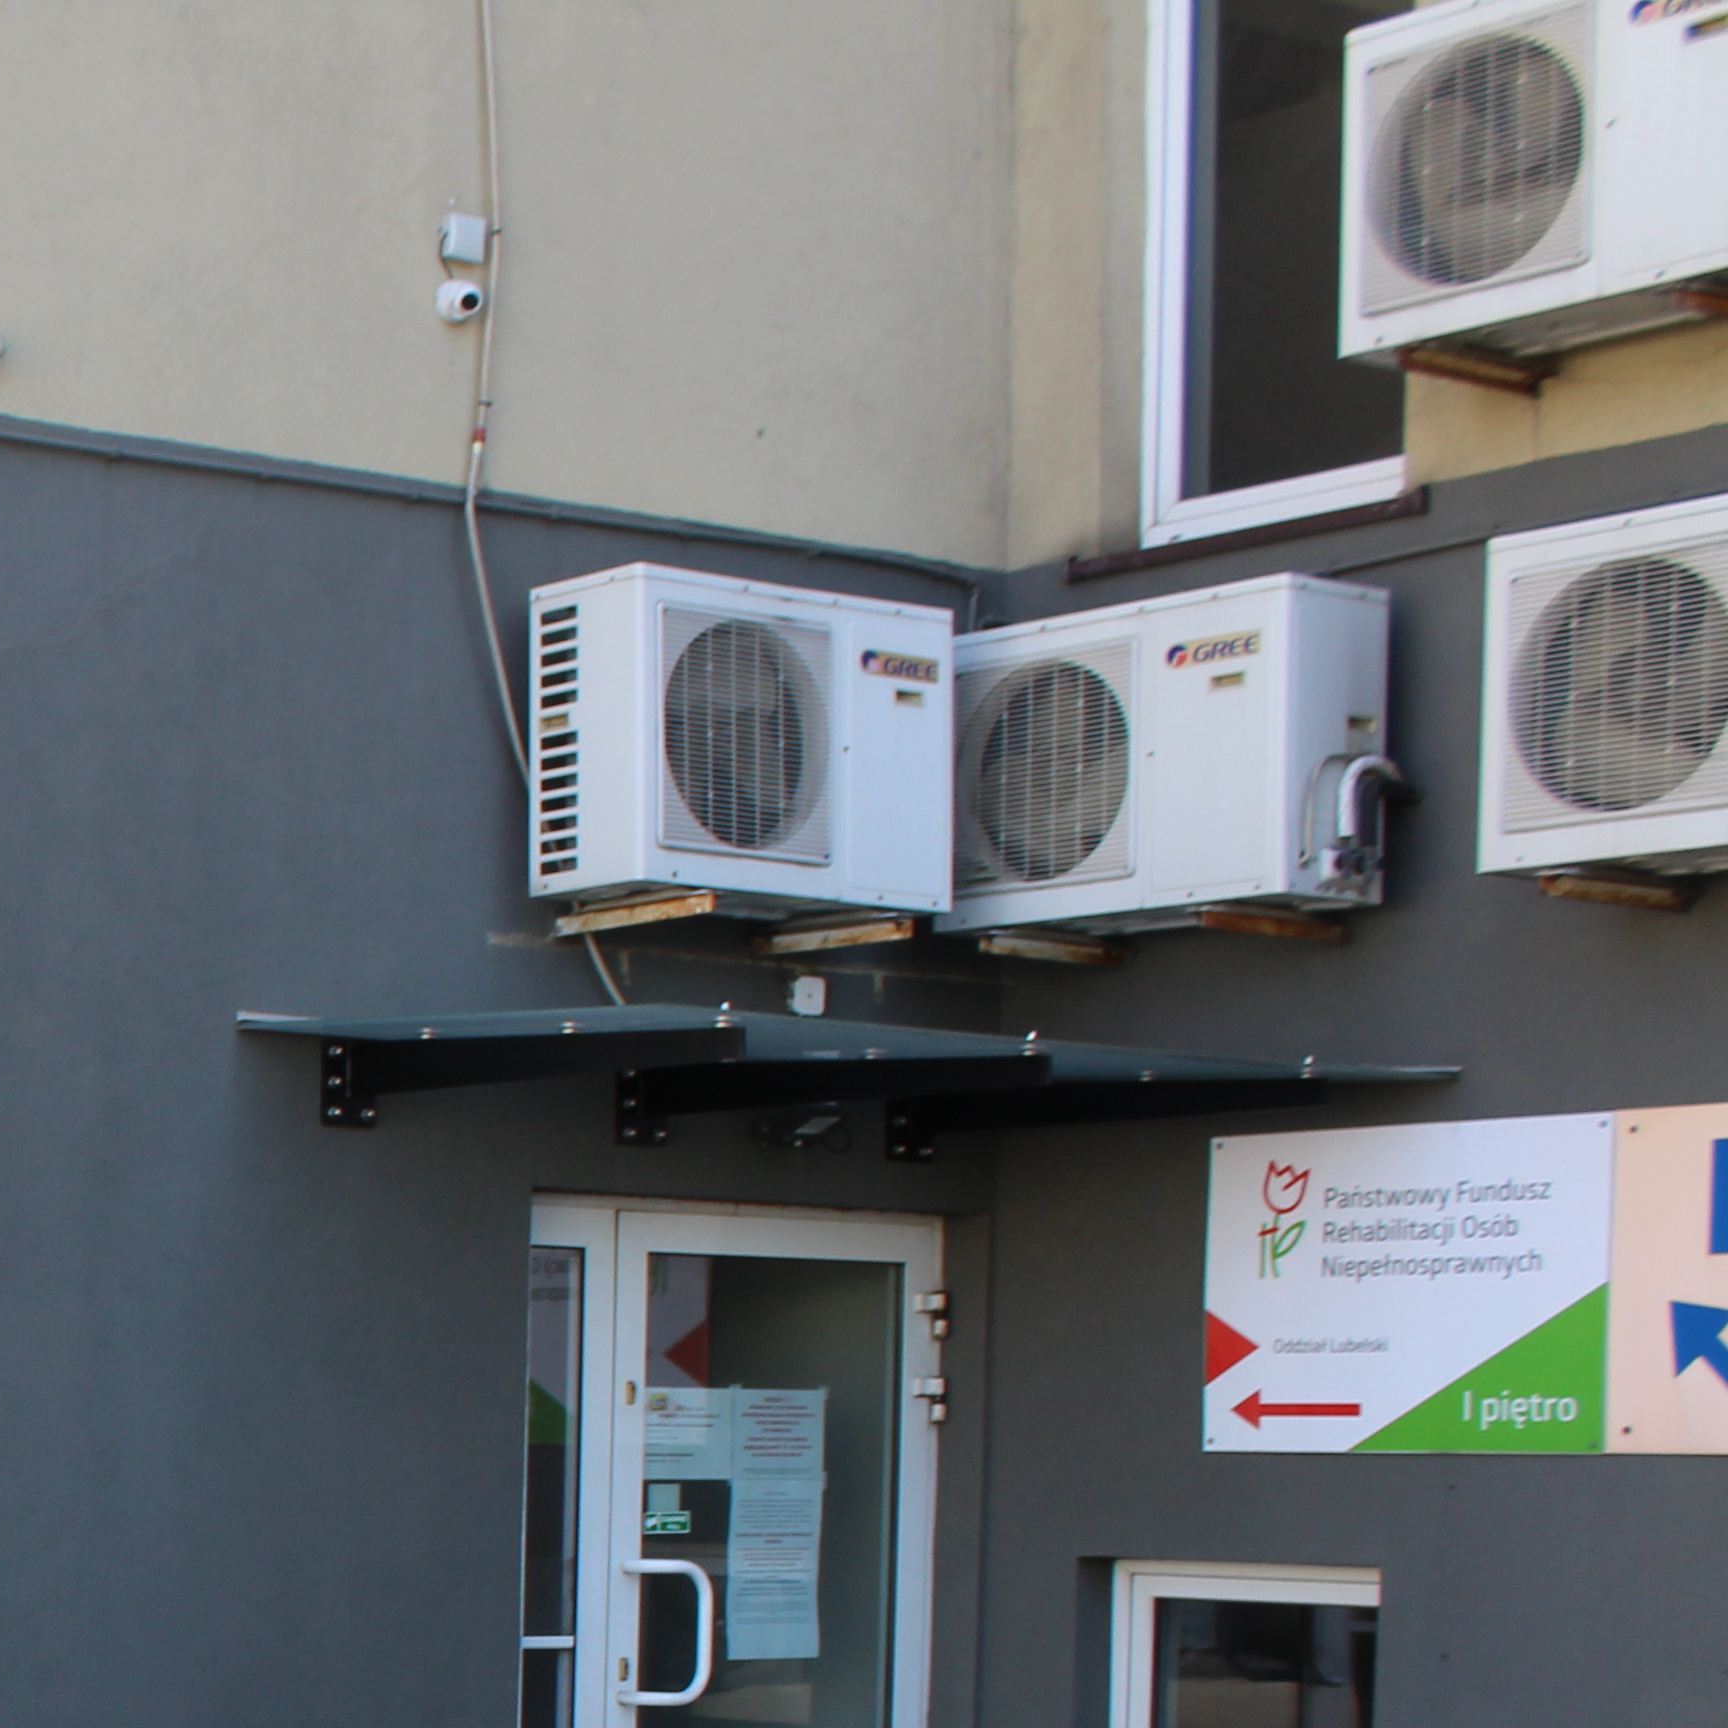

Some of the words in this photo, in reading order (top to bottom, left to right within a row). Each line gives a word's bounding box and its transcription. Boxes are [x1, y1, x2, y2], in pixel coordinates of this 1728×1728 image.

[1192, 635, 1260, 662] GREE
[883, 657, 939, 682] GREE
[1323, 1185, 1451, 1211] Państwowy
[1455, 1179, 1553, 1203] Fundusz
[1322, 1217, 1454, 1247] Rehabilitacji
[1460, 1214, 1520, 1240] Osób
[1320, 1250, 1544, 1283] Niepełnosprawnych
[1462, 1391, 1473, 1422] I
[1480, 1390, 1580, 1431] piętro
